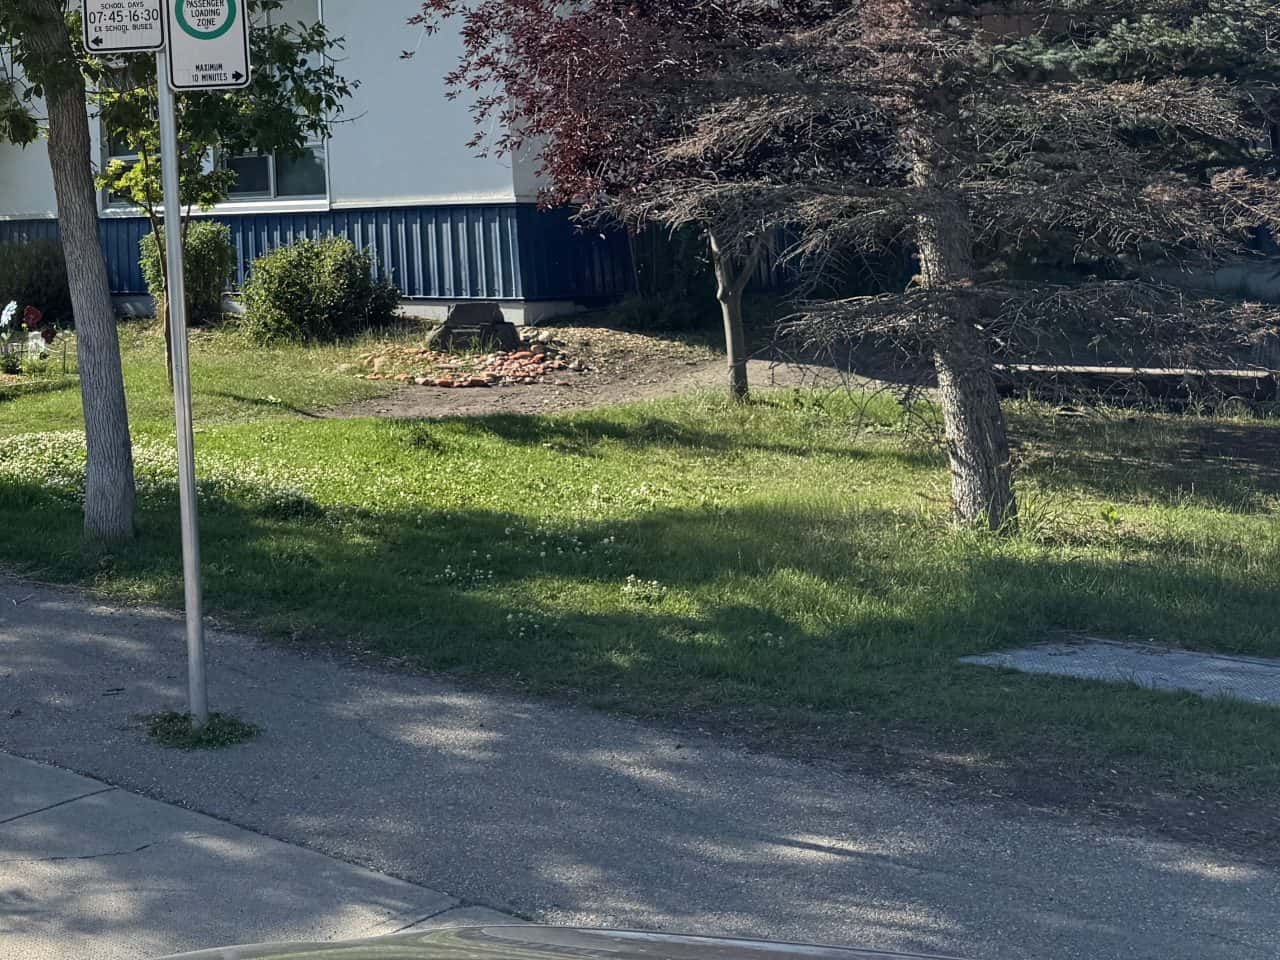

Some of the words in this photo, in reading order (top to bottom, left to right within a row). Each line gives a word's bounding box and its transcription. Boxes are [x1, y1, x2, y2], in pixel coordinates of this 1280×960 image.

[100, 2, 125, 10] SCHOOL
[127, 1, 145, 9] DAYS
[88, 8, 159, 24] 07:45-16:30
[191, 8, 221, 18] LOADING
[196, 17, 216, 27] ZONE
[104, 24, 129, 32] SCHOOL
[132, 23, 153, 31] BUSES
[195, 63, 223, 72] MAXIMUM
[192, 74, 199, 82] 10
[201, 72, 228, 82] MINUTES
